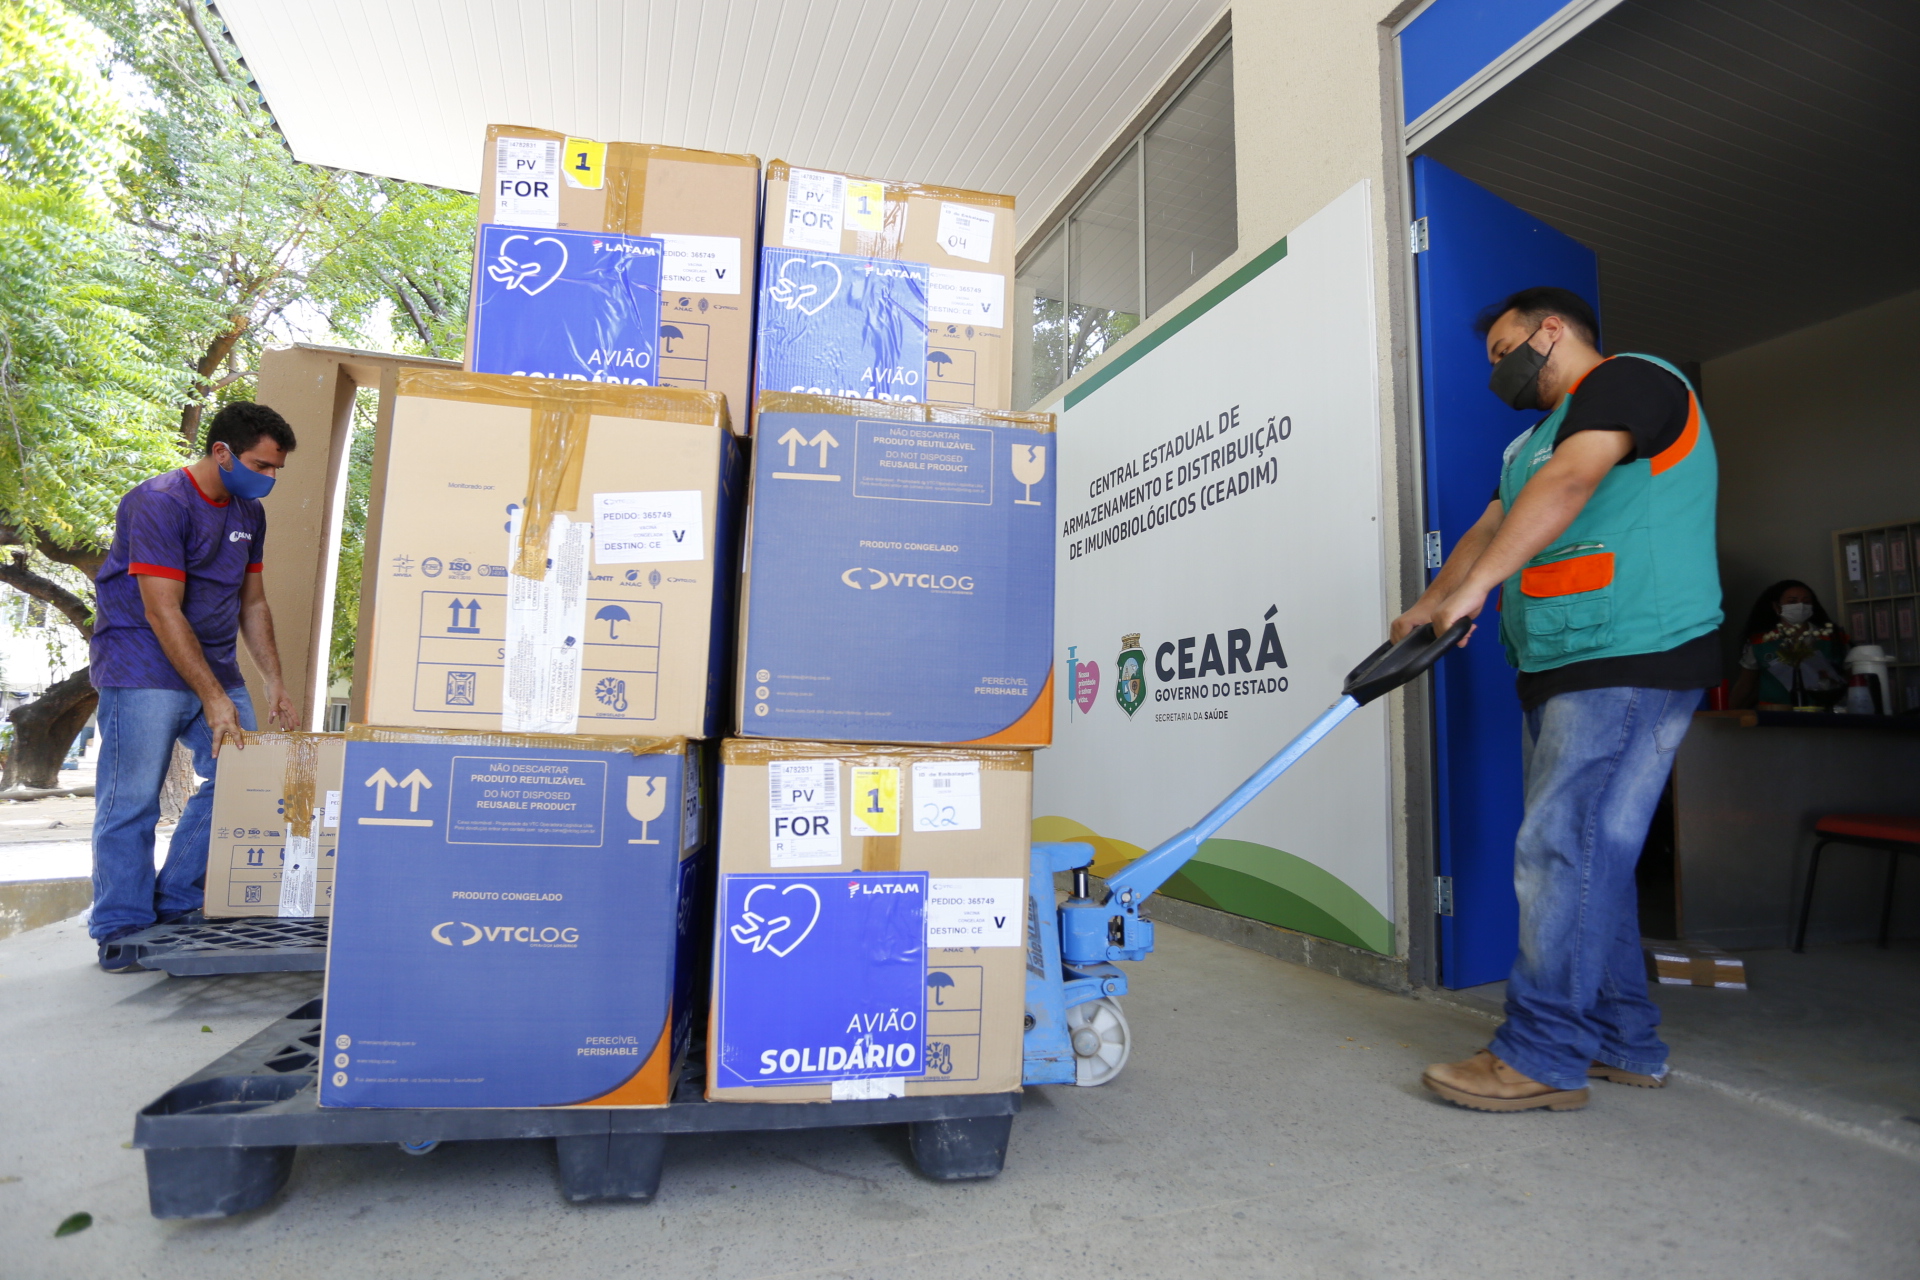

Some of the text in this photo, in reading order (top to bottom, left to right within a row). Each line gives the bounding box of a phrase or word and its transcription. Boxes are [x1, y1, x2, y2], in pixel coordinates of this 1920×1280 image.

[516, 159, 537, 170] PV
[575, 152, 591, 171] 1
[500, 180, 549, 198] FOR
[806, 191, 824, 202] PV
[857, 195, 872, 215] 1
[788, 208, 834, 230] FOR
[947, 234, 967, 250] 04
[605, 243, 656, 256] LATAM
[663, 250, 716, 259] EDIDO: 365749
[715, 268, 726, 280] V
[876, 266, 922, 280] LATAM
[959, 285, 982, 294] 365749
[962, 308, 973, 316] CE
[980, 302, 992, 313] V
[587, 347, 651, 369] AVIÃO
[860, 366, 919, 386] AVIÃO
[889, 428, 960, 440] NÃO DESCARTAR
[873, 436, 976, 451] PRODUTO REUTILIZÁVEL
[885, 450, 963, 463] DO NOT DISPOSED
[1089, 404, 1240, 499] CENTRAL ESTADUAL DE
[879, 460, 969, 473] REUSABLE PRODUCT
[1063, 415, 1292, 538] ARMAZENAMENTO E DISTRIBUIÇÃO
[1069, 456, 1278, 561] DE IMUNOBIOLÓGICOS (CEADIM)
[603, 511, 672, 520] PEDIDO: 365749
[672, 529, 686, 543] V
[604, 541, 661, 550] DESTINO: CE
[859, 540, 959, 553] PRODUTO CONGELADO
[448, 562, 472, 572] ISO
[888, 572, 975, 591] VTCLOG
[1155, 603, 1288, 683] CEARÁ
[981, 677, 1028, 687] PERECÍVEL
[974, 686, 1028, 696] PERISHABLE
[1155, 676, 1289, 703] GOVERNO DO ESTADO
[1155, 707, 1229, 723] SECRETARIA DA SAÚDE
[489, 763, 569, 774] NÃO DESCARTAR
[470, 774, 586, 786] PRODUTO REUTILIZÁVEL
[483, 789, 571, 801] DO NOT DISPOSED
[792, 789, 814, 803] PV
[866, 788, 884, 813] 1
[476, 800, 577, 811] REUSABLE PRODUCT
[919, 802, 959, 828] 22
[775, 815, 830, 837] FOR
[776, 842, 784, 851] R
[862, 882, 919, 895] LATAM
[452, 891, 563, 902] PRODUTO CONGELADO
[931, 897, 995, 905] PEDIDO: 365749
[993, 916, 1006, 929] V
[483, 926, 579, 943] VTCLOG
[930, 926, 983, 935] DESTINO: CE
[846, 1008, 917, 1034] AVIÃO
[586, 1035, 639, 1046] PERECÍVEL
[576, 1047, 639, 1056] PERISHABLE
[758, 1038, 917, 1075] SOLIDÁRIO
